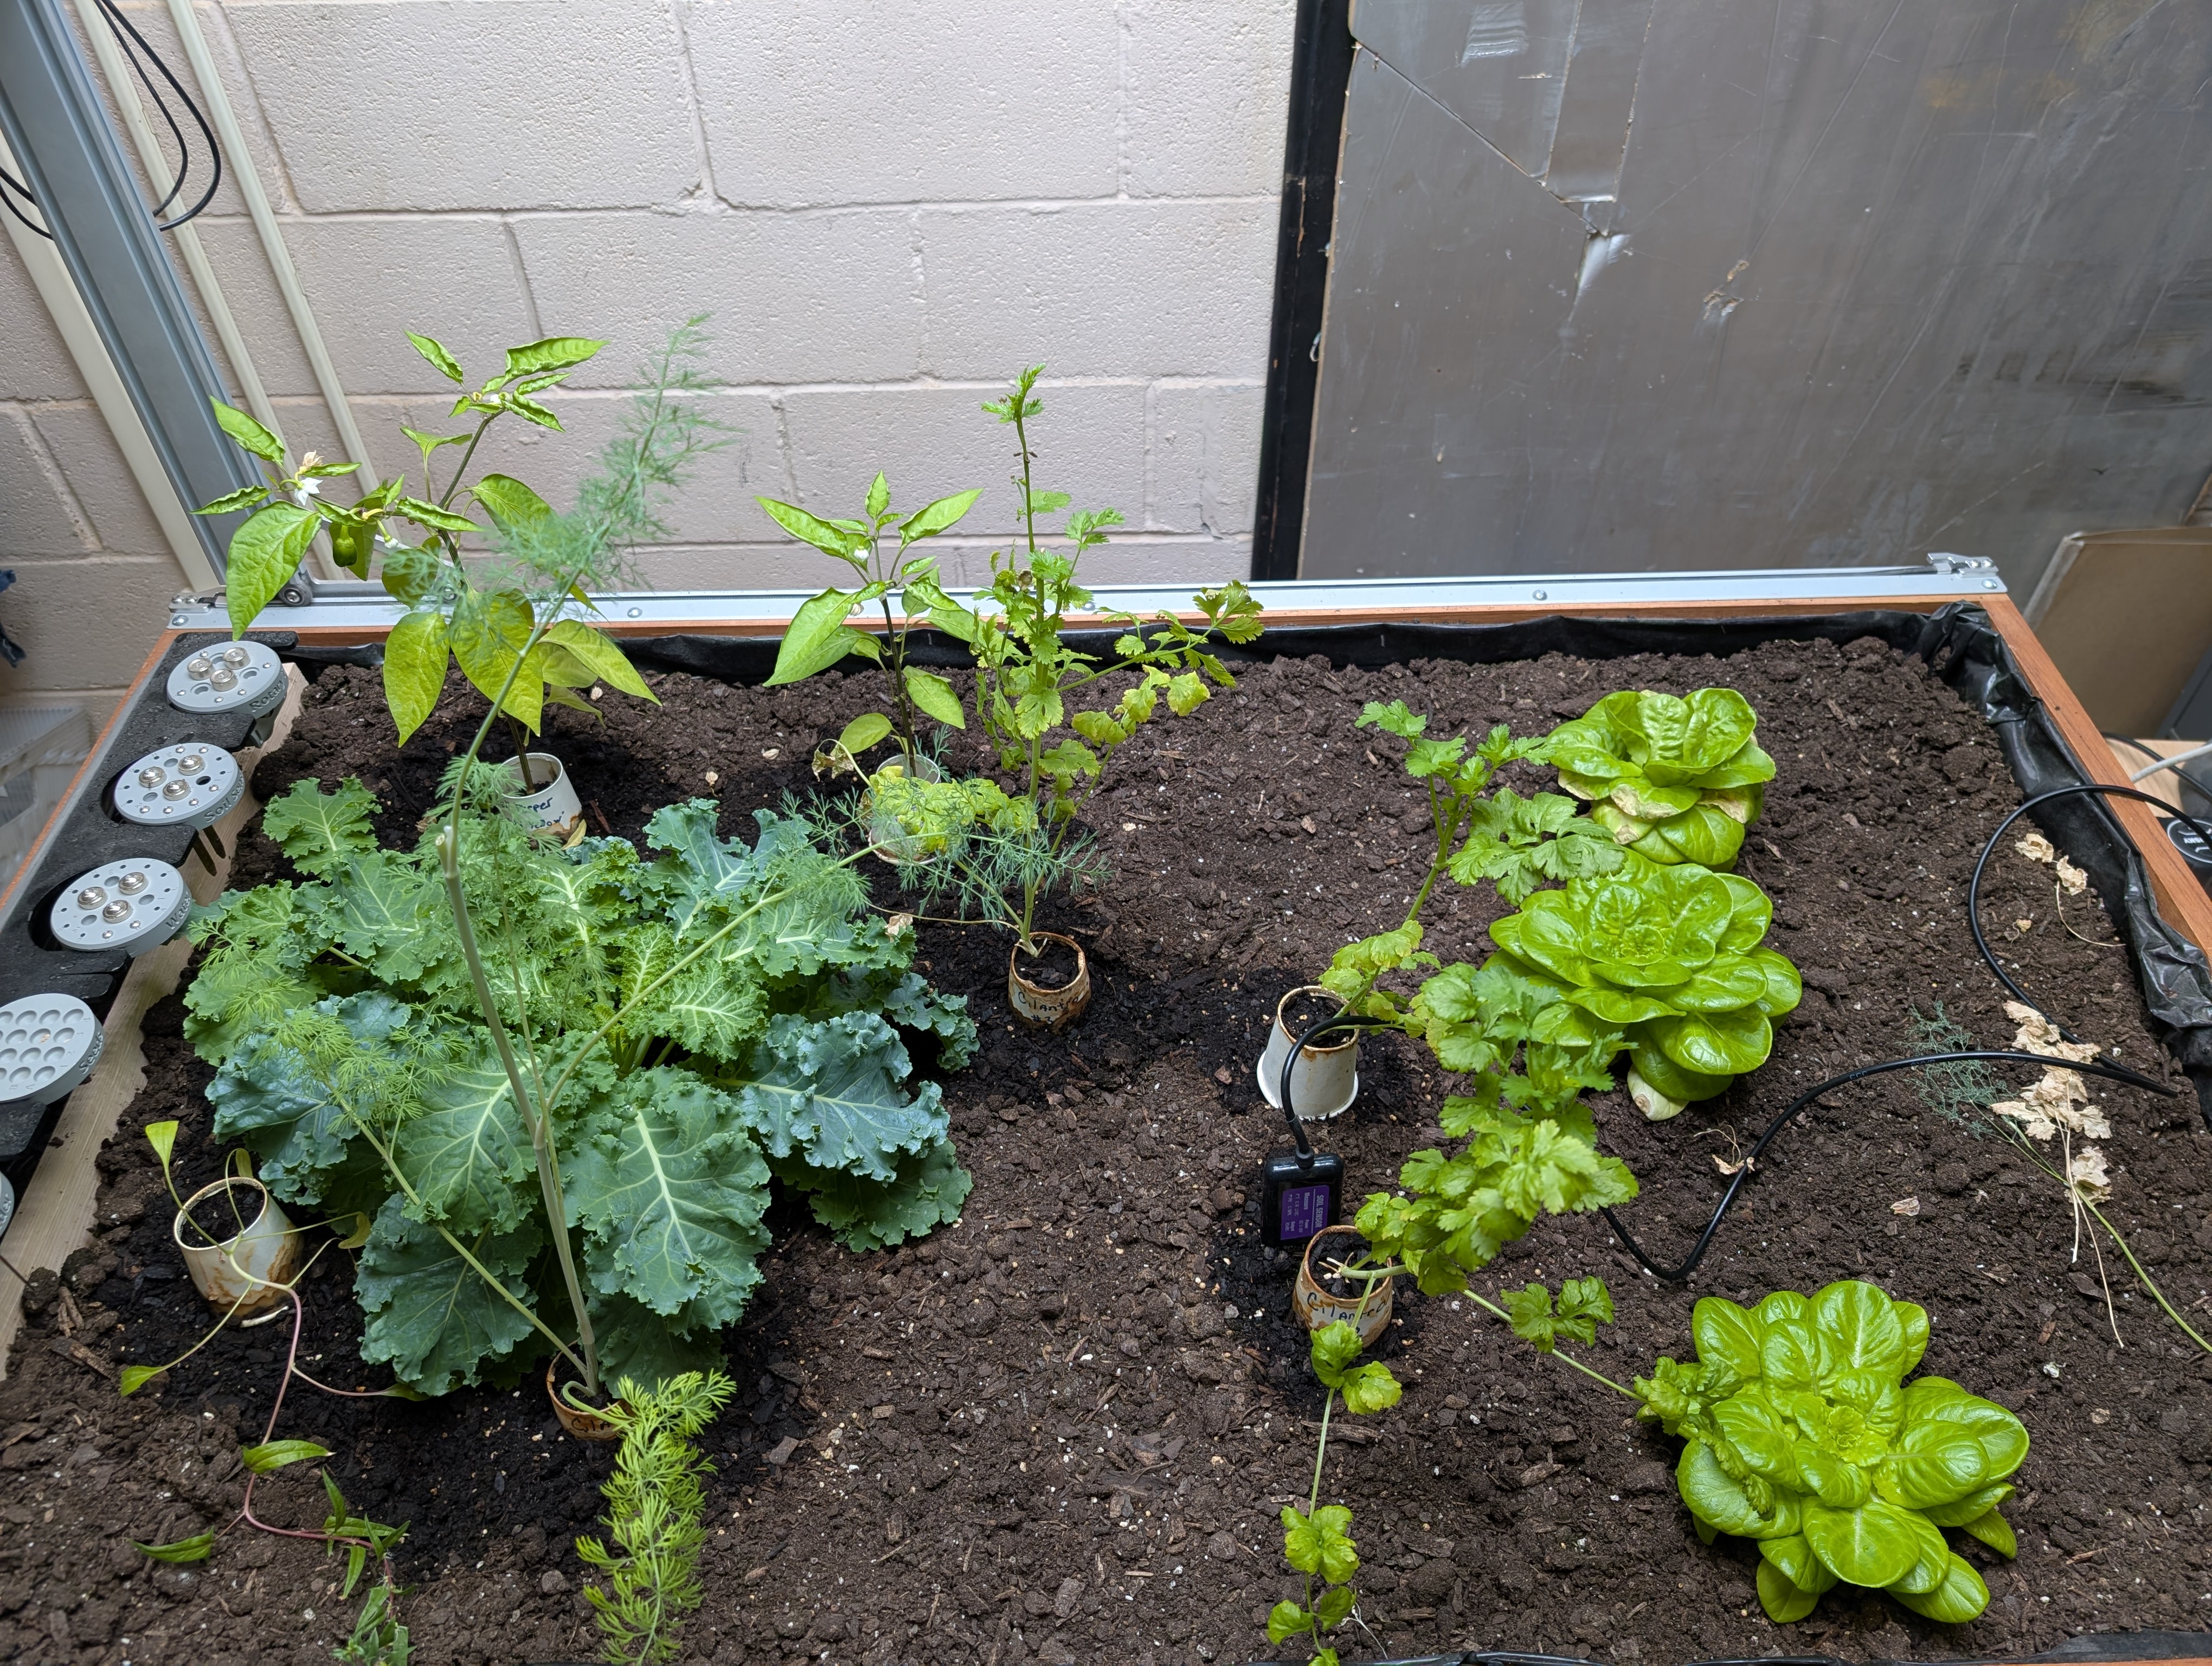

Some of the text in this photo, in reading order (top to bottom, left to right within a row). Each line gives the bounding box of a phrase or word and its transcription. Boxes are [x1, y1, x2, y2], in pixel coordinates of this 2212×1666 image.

[249, 677, 285, 713] Rotary
[204, 797, 232, 823] Soil
[165, 891, 190, 930] Water
[79, 1030, 104, 1074] Seeds
[1315, 1208, 1323, 1228] SENSOR
